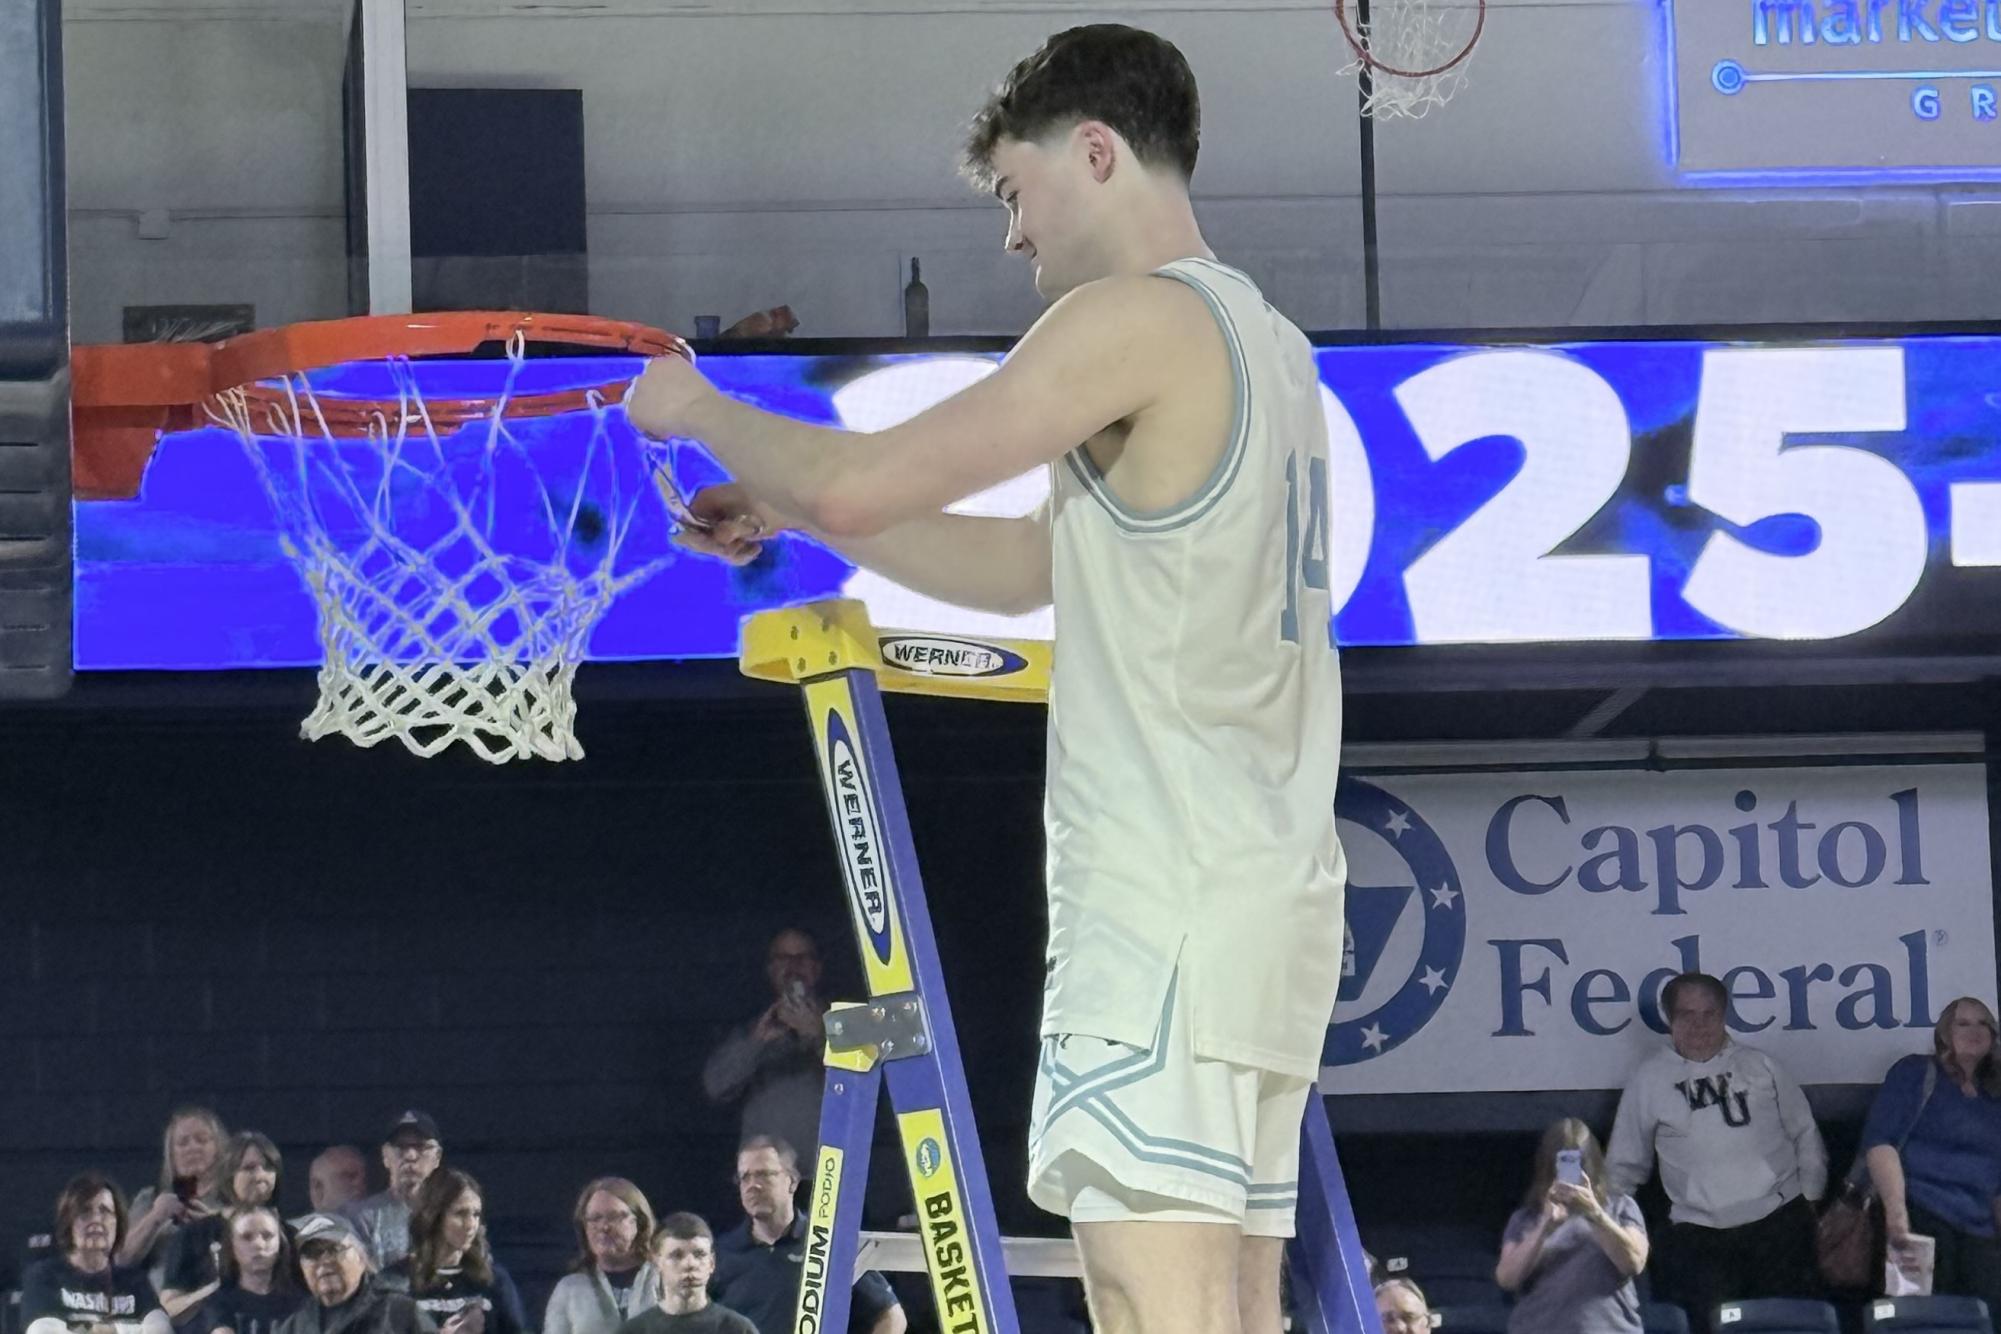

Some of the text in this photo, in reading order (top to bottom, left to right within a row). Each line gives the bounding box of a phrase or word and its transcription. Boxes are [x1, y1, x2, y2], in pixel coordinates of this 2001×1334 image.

[1281, 448, 1337, 650] 14
[893, 643, 998, 670] WERNER
[837, 758, 882, 917] WERNER
[1484, 787, 1931, 915] Capitol
[1486, 928, 1938, 1038] Federal
[818, 1156, 836, 1219] PODIO
